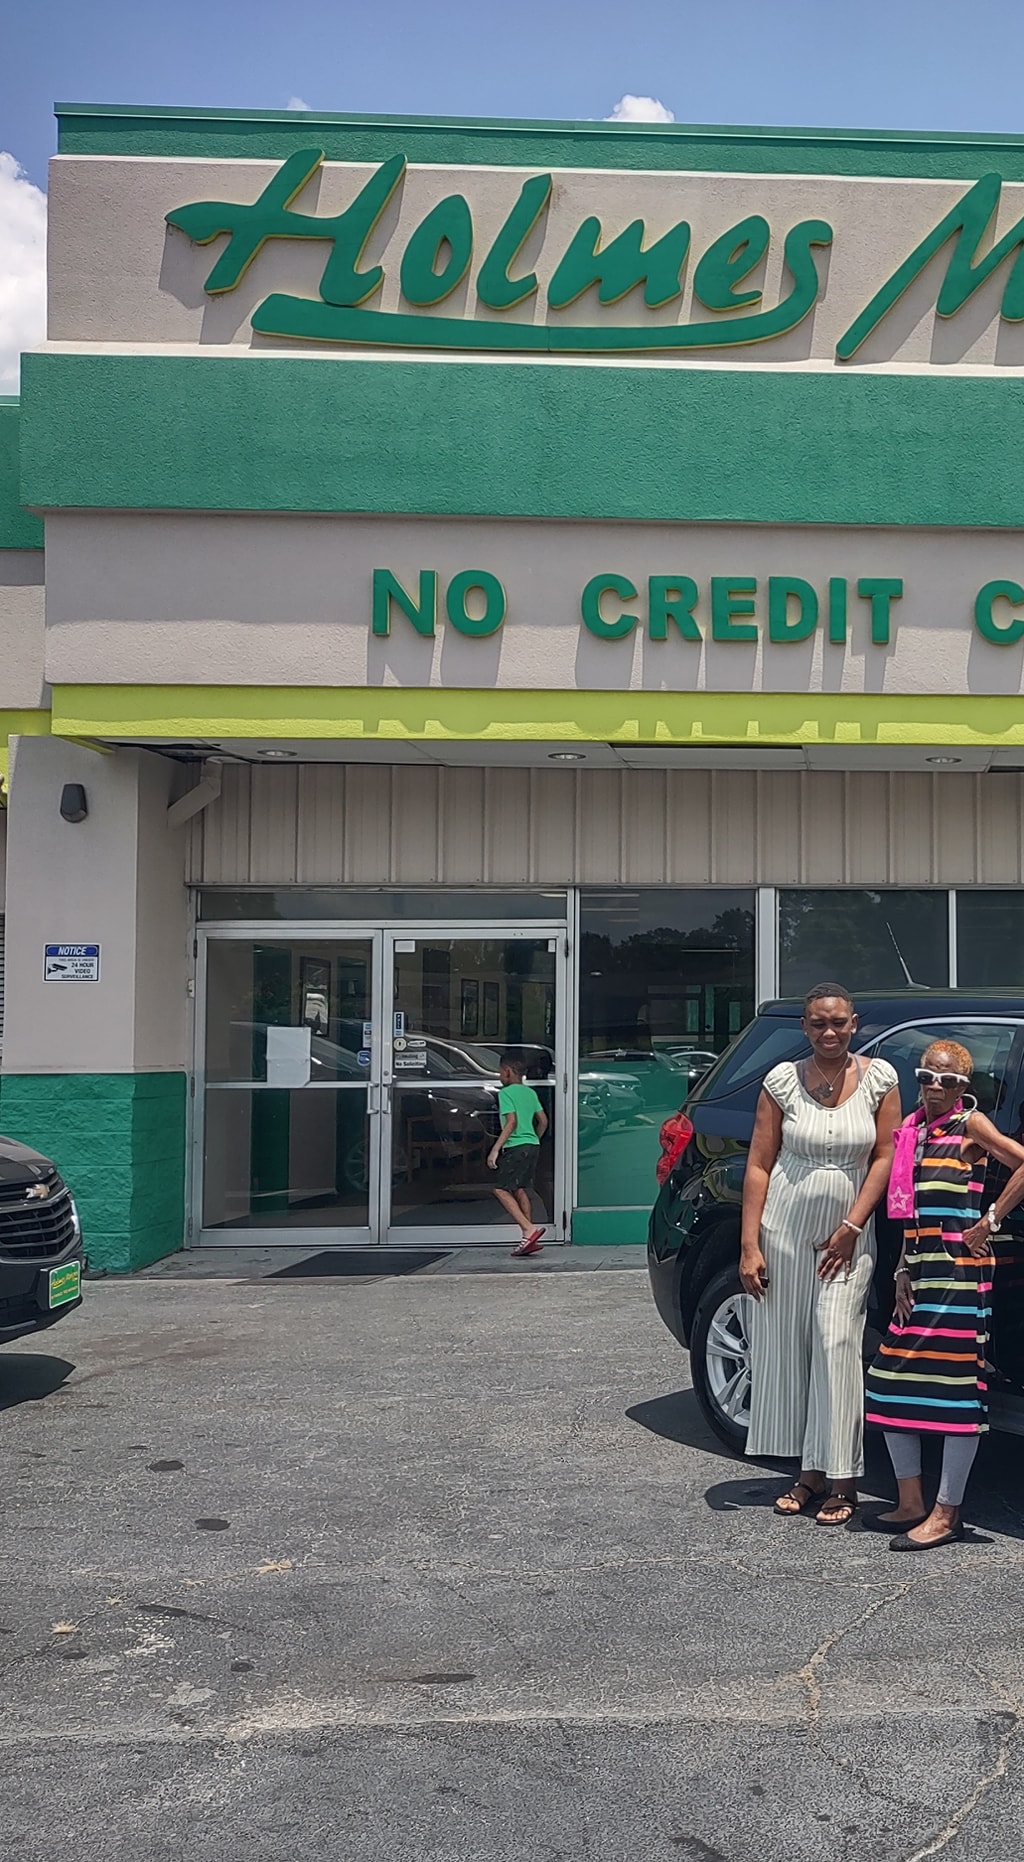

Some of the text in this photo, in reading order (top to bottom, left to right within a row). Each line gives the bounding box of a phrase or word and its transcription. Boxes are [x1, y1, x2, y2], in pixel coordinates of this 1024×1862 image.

[164, 148, 834, 352] Holmes
[371, 568, 507, 638] NO
[580, 572, 904, 645] CREDIT
[57, 946, 88, 956] NOTICE
